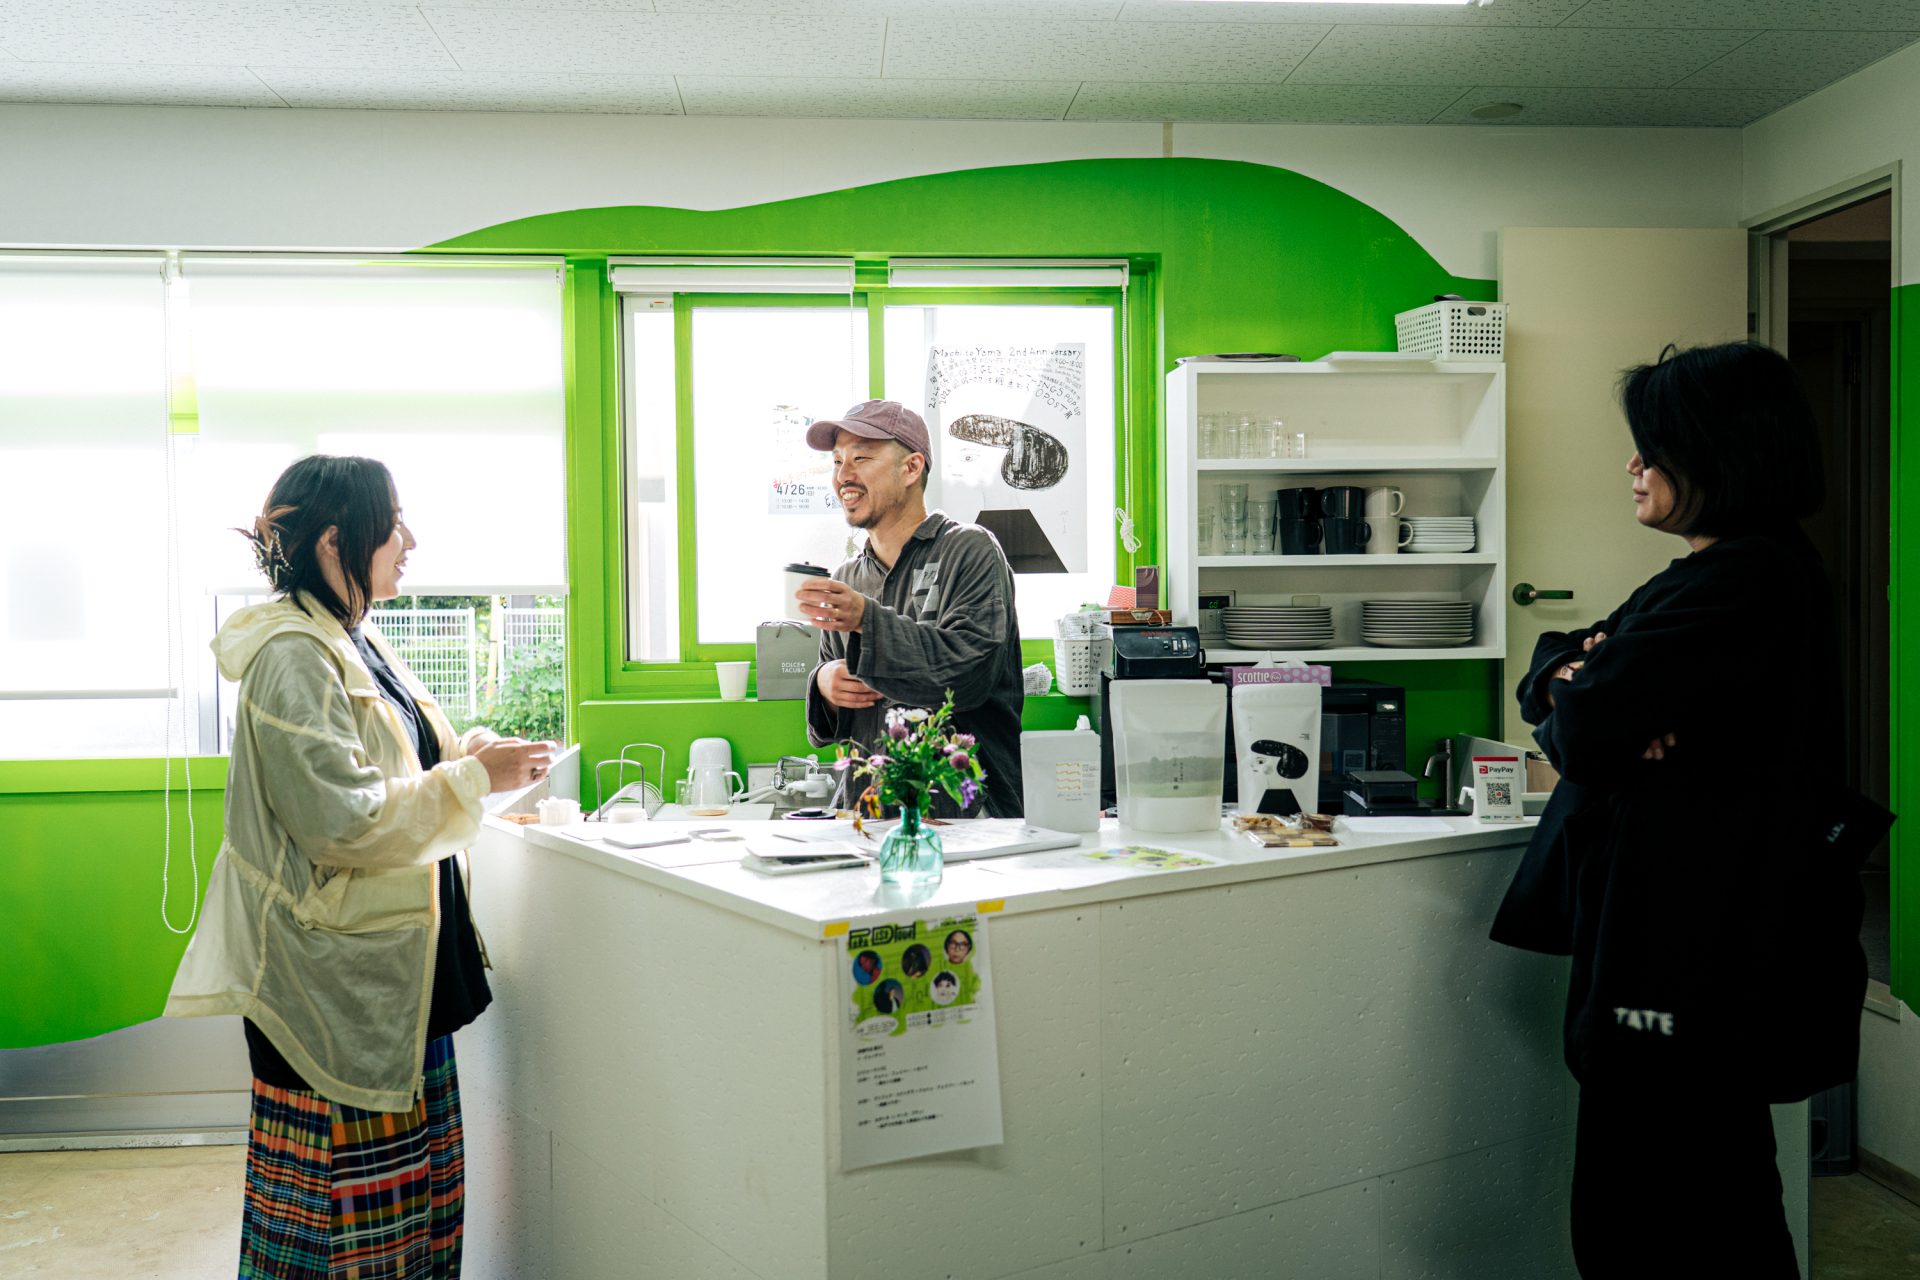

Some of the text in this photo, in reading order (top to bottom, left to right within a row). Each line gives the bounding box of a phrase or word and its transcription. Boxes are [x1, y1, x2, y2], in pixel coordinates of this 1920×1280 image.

[933, 348, 963, 359] Machi
[975, 347, 1002, 357] Yama
[1009, 347, 1027, 357] 2nd
[776, 484, 805, 496] 4/26
[1237, 671, 1270, 683] scottie
[1613, 1007, 1674, 1036] TATE
